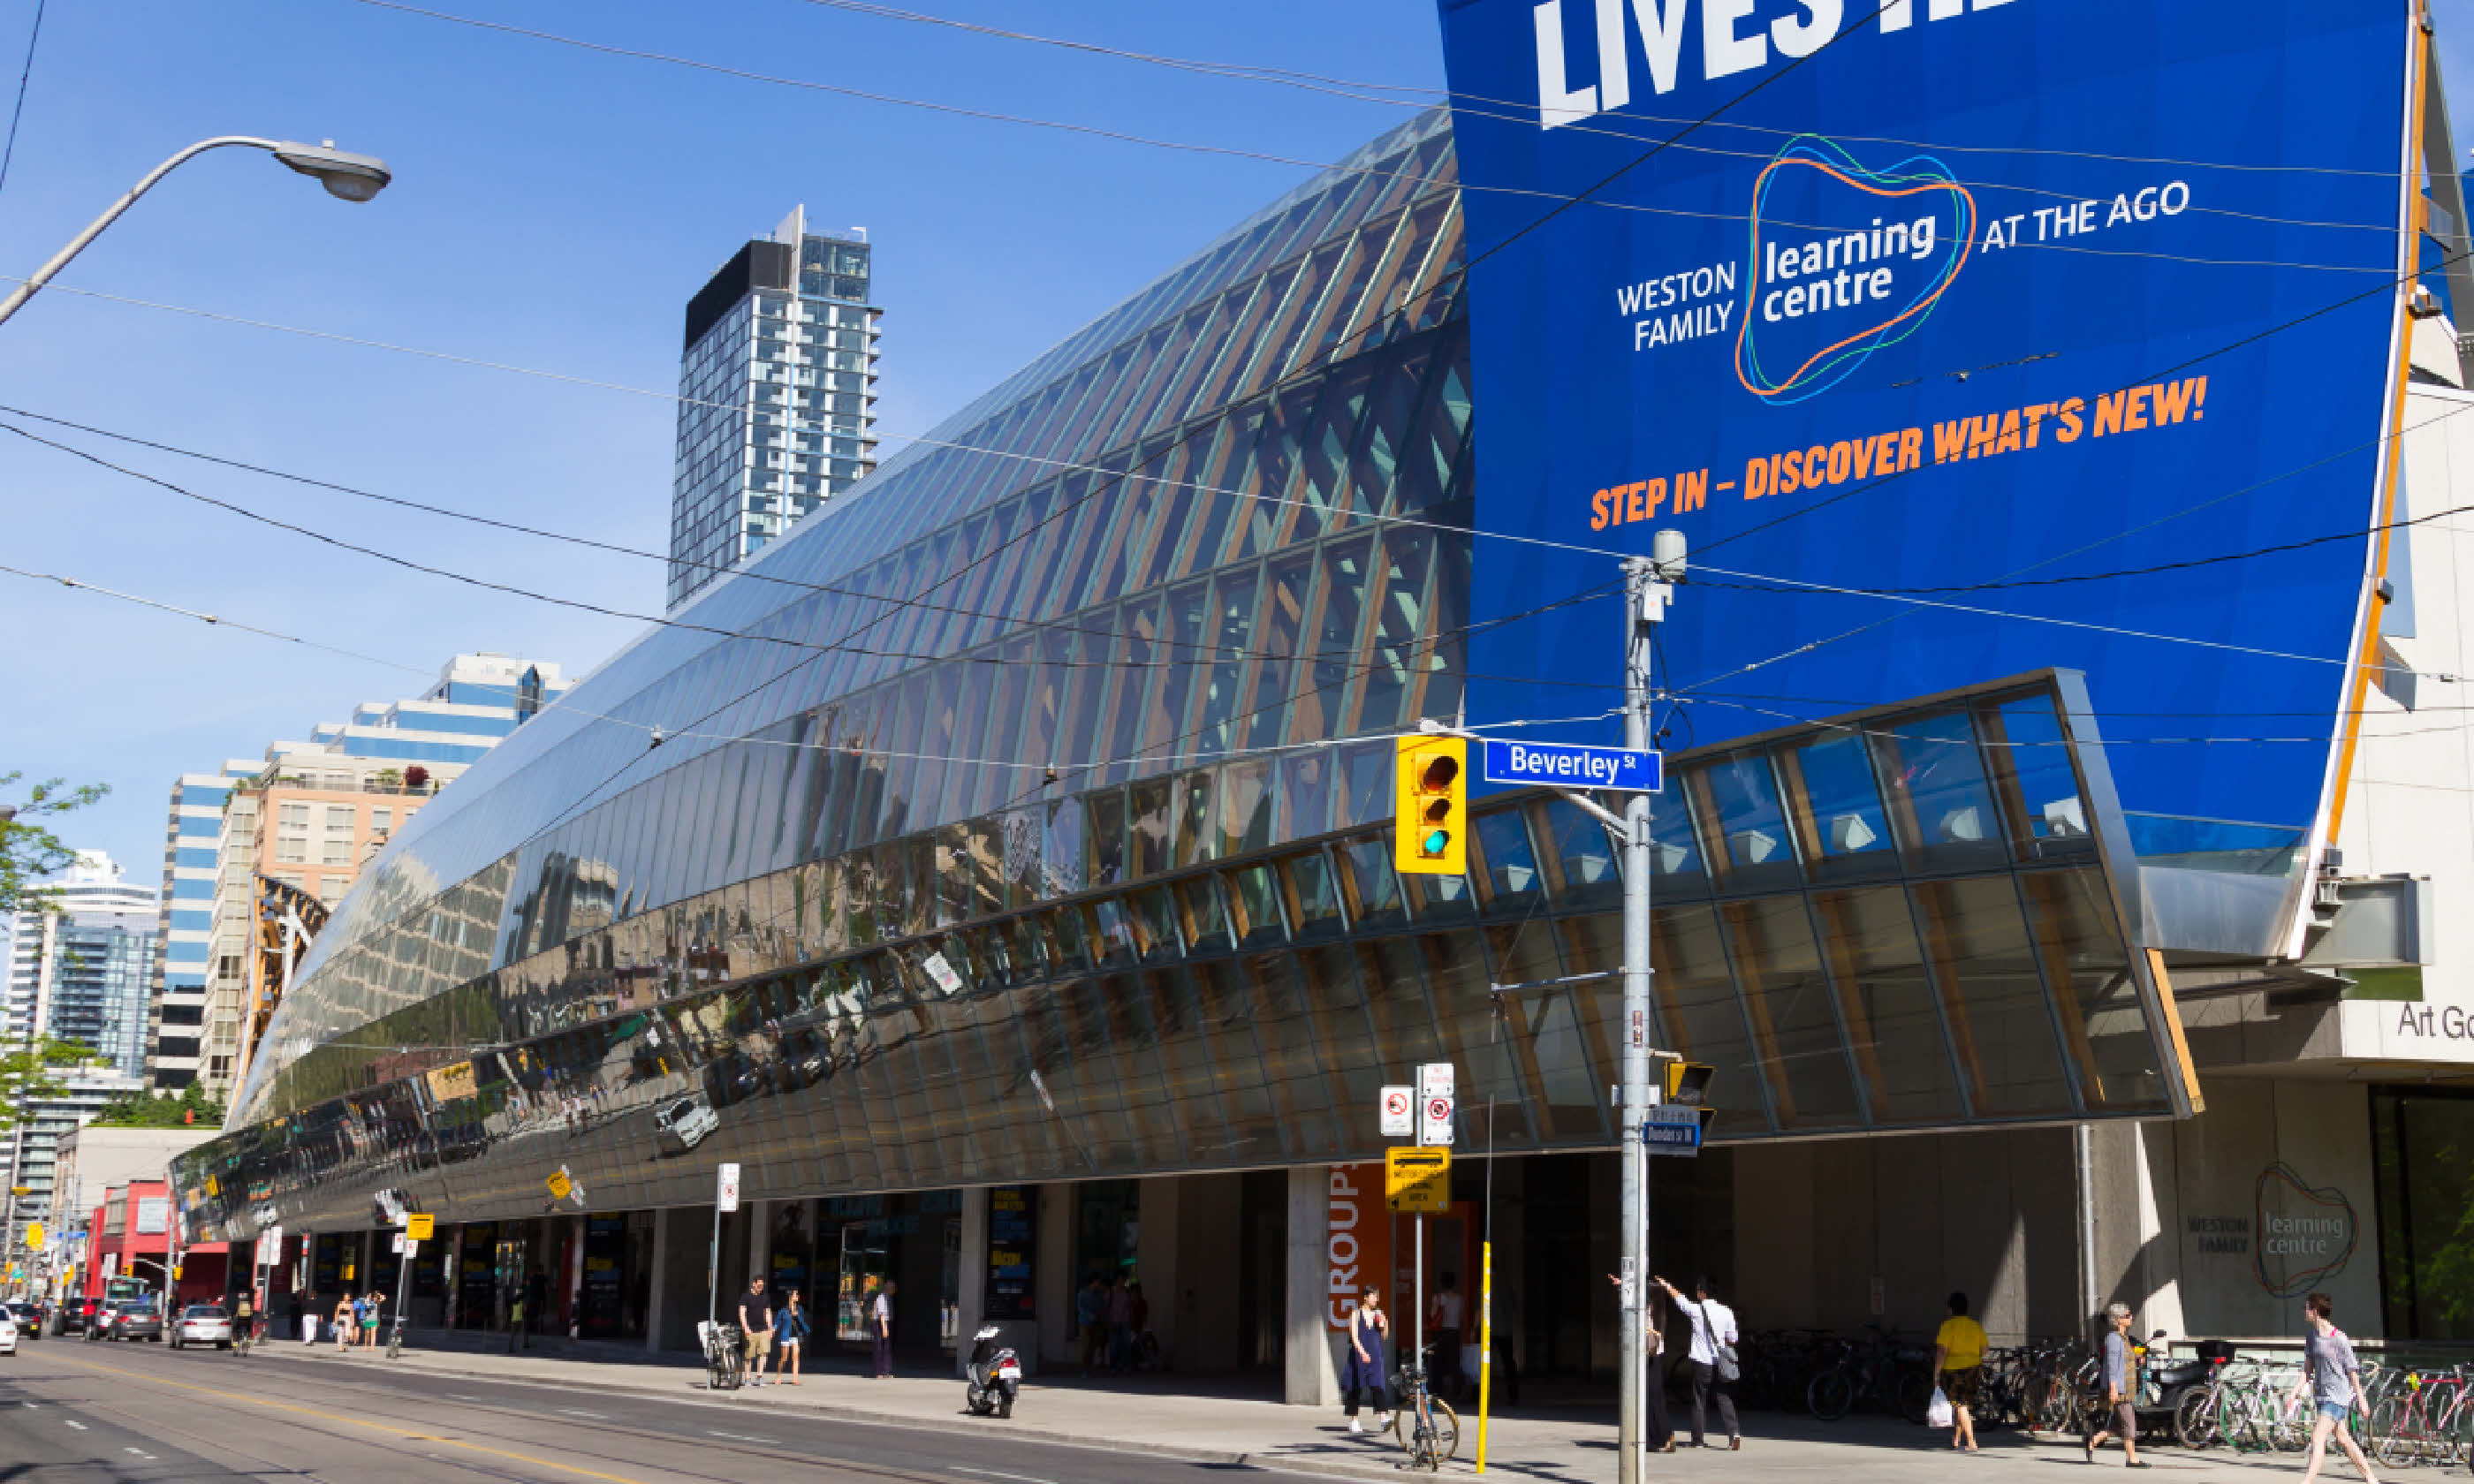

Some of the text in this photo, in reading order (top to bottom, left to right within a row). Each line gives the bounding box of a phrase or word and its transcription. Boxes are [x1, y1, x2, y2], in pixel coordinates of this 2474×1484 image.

[1982, 180, 2189, 254] AT THE AGO
[1765, 216, 1935, 283] learning
[1618, 261, 1735, 316] WESTON
[1764, 268, 1893, 322] centre
[1634, 300, 1734, 351] FAMILY
[1590, 477, 1667, 530] STEP
[1672, 468, 1708, 514] IN
[1743, 427, 1923, 500] DISCOVER
[1933, 397, 2084, 465] WHAT'S
[2092, 375, 2207, 438] NEW!
[1511, 746, 1620, 784] Beverley
[2398, 1002, 2436, 1037] Art
[1329, 1162, 1359, 1329] GROUP
[2188, 1215, 2249, 1234] WESTON
[2198, 1235, 2249, 1254] FAMILY
[2265, 1211, 2344, 1240] learning
[2265, 1236, 2326, 1255] centre
